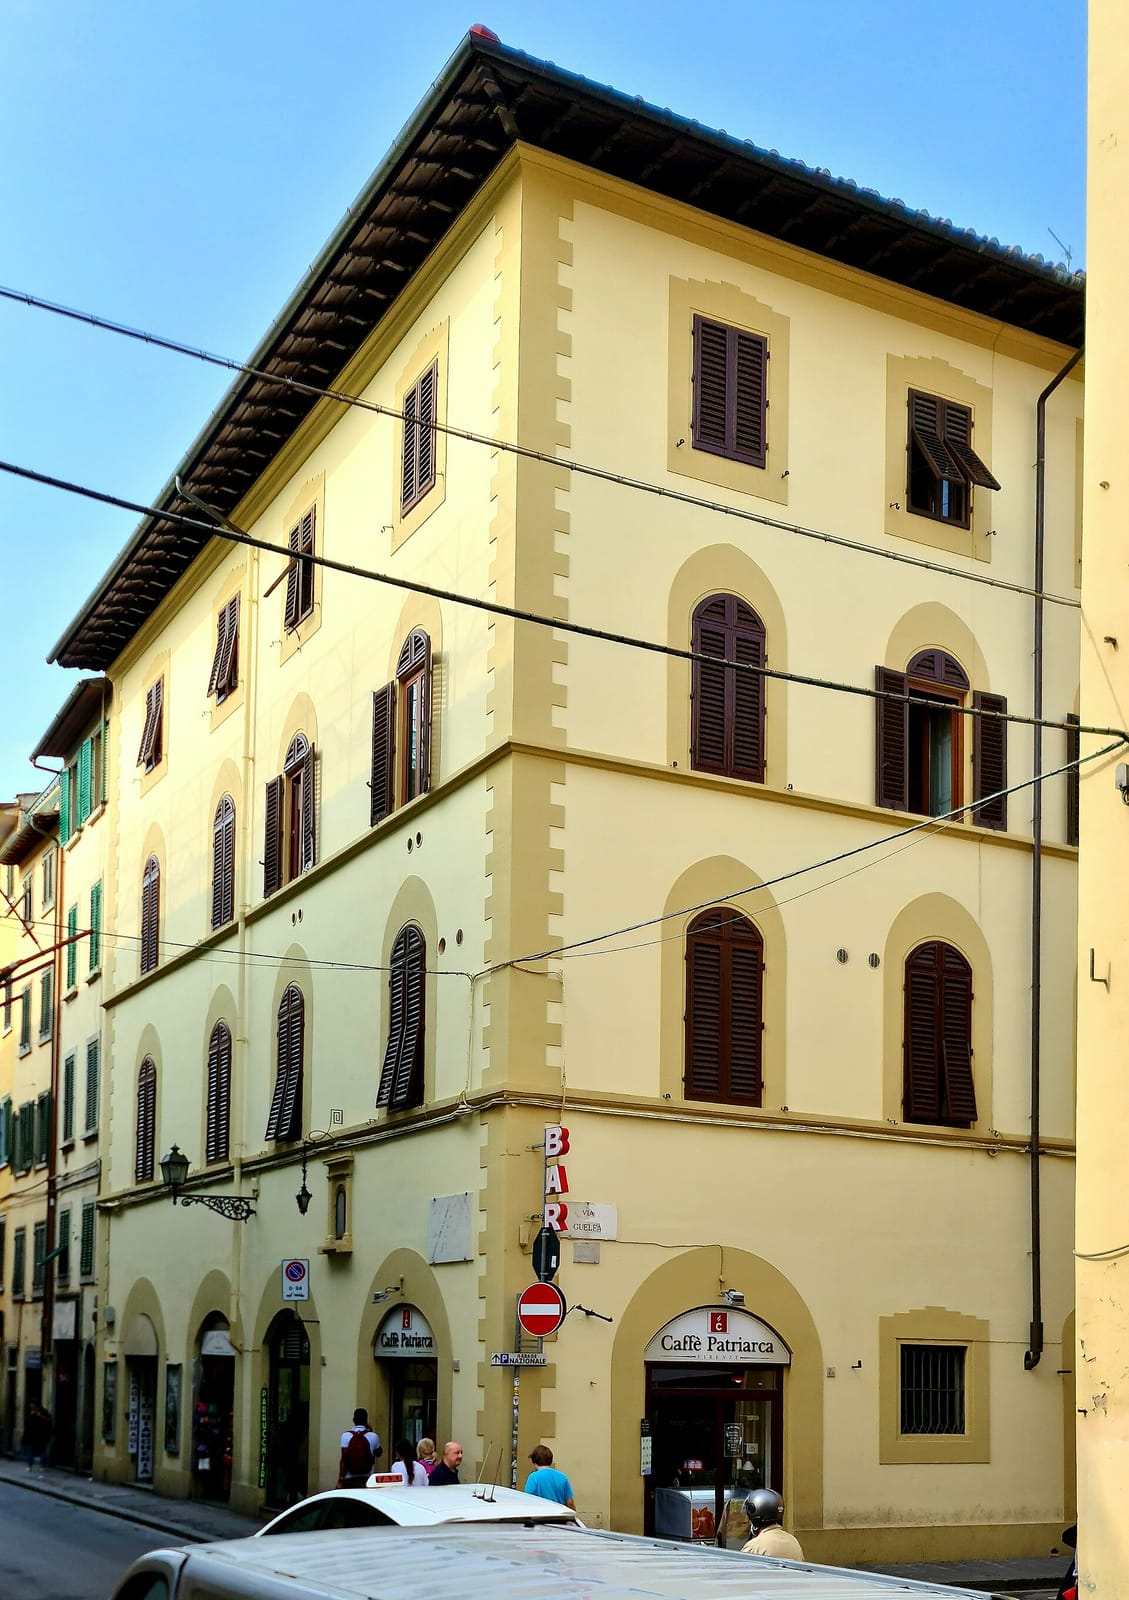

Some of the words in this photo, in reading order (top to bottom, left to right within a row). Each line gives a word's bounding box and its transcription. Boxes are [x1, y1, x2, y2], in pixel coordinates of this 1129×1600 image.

[543, 1127, 569, 1232] BAR
[573, 1223, 602, 1232] GUELFA
[400, 1332, 433, 1348] Patriarca
[661, 1335, 702, 1352] Caffè
[707, 1336, 775, 1353] Patriarca
[376, 1475, 403, 1483] TAXI
